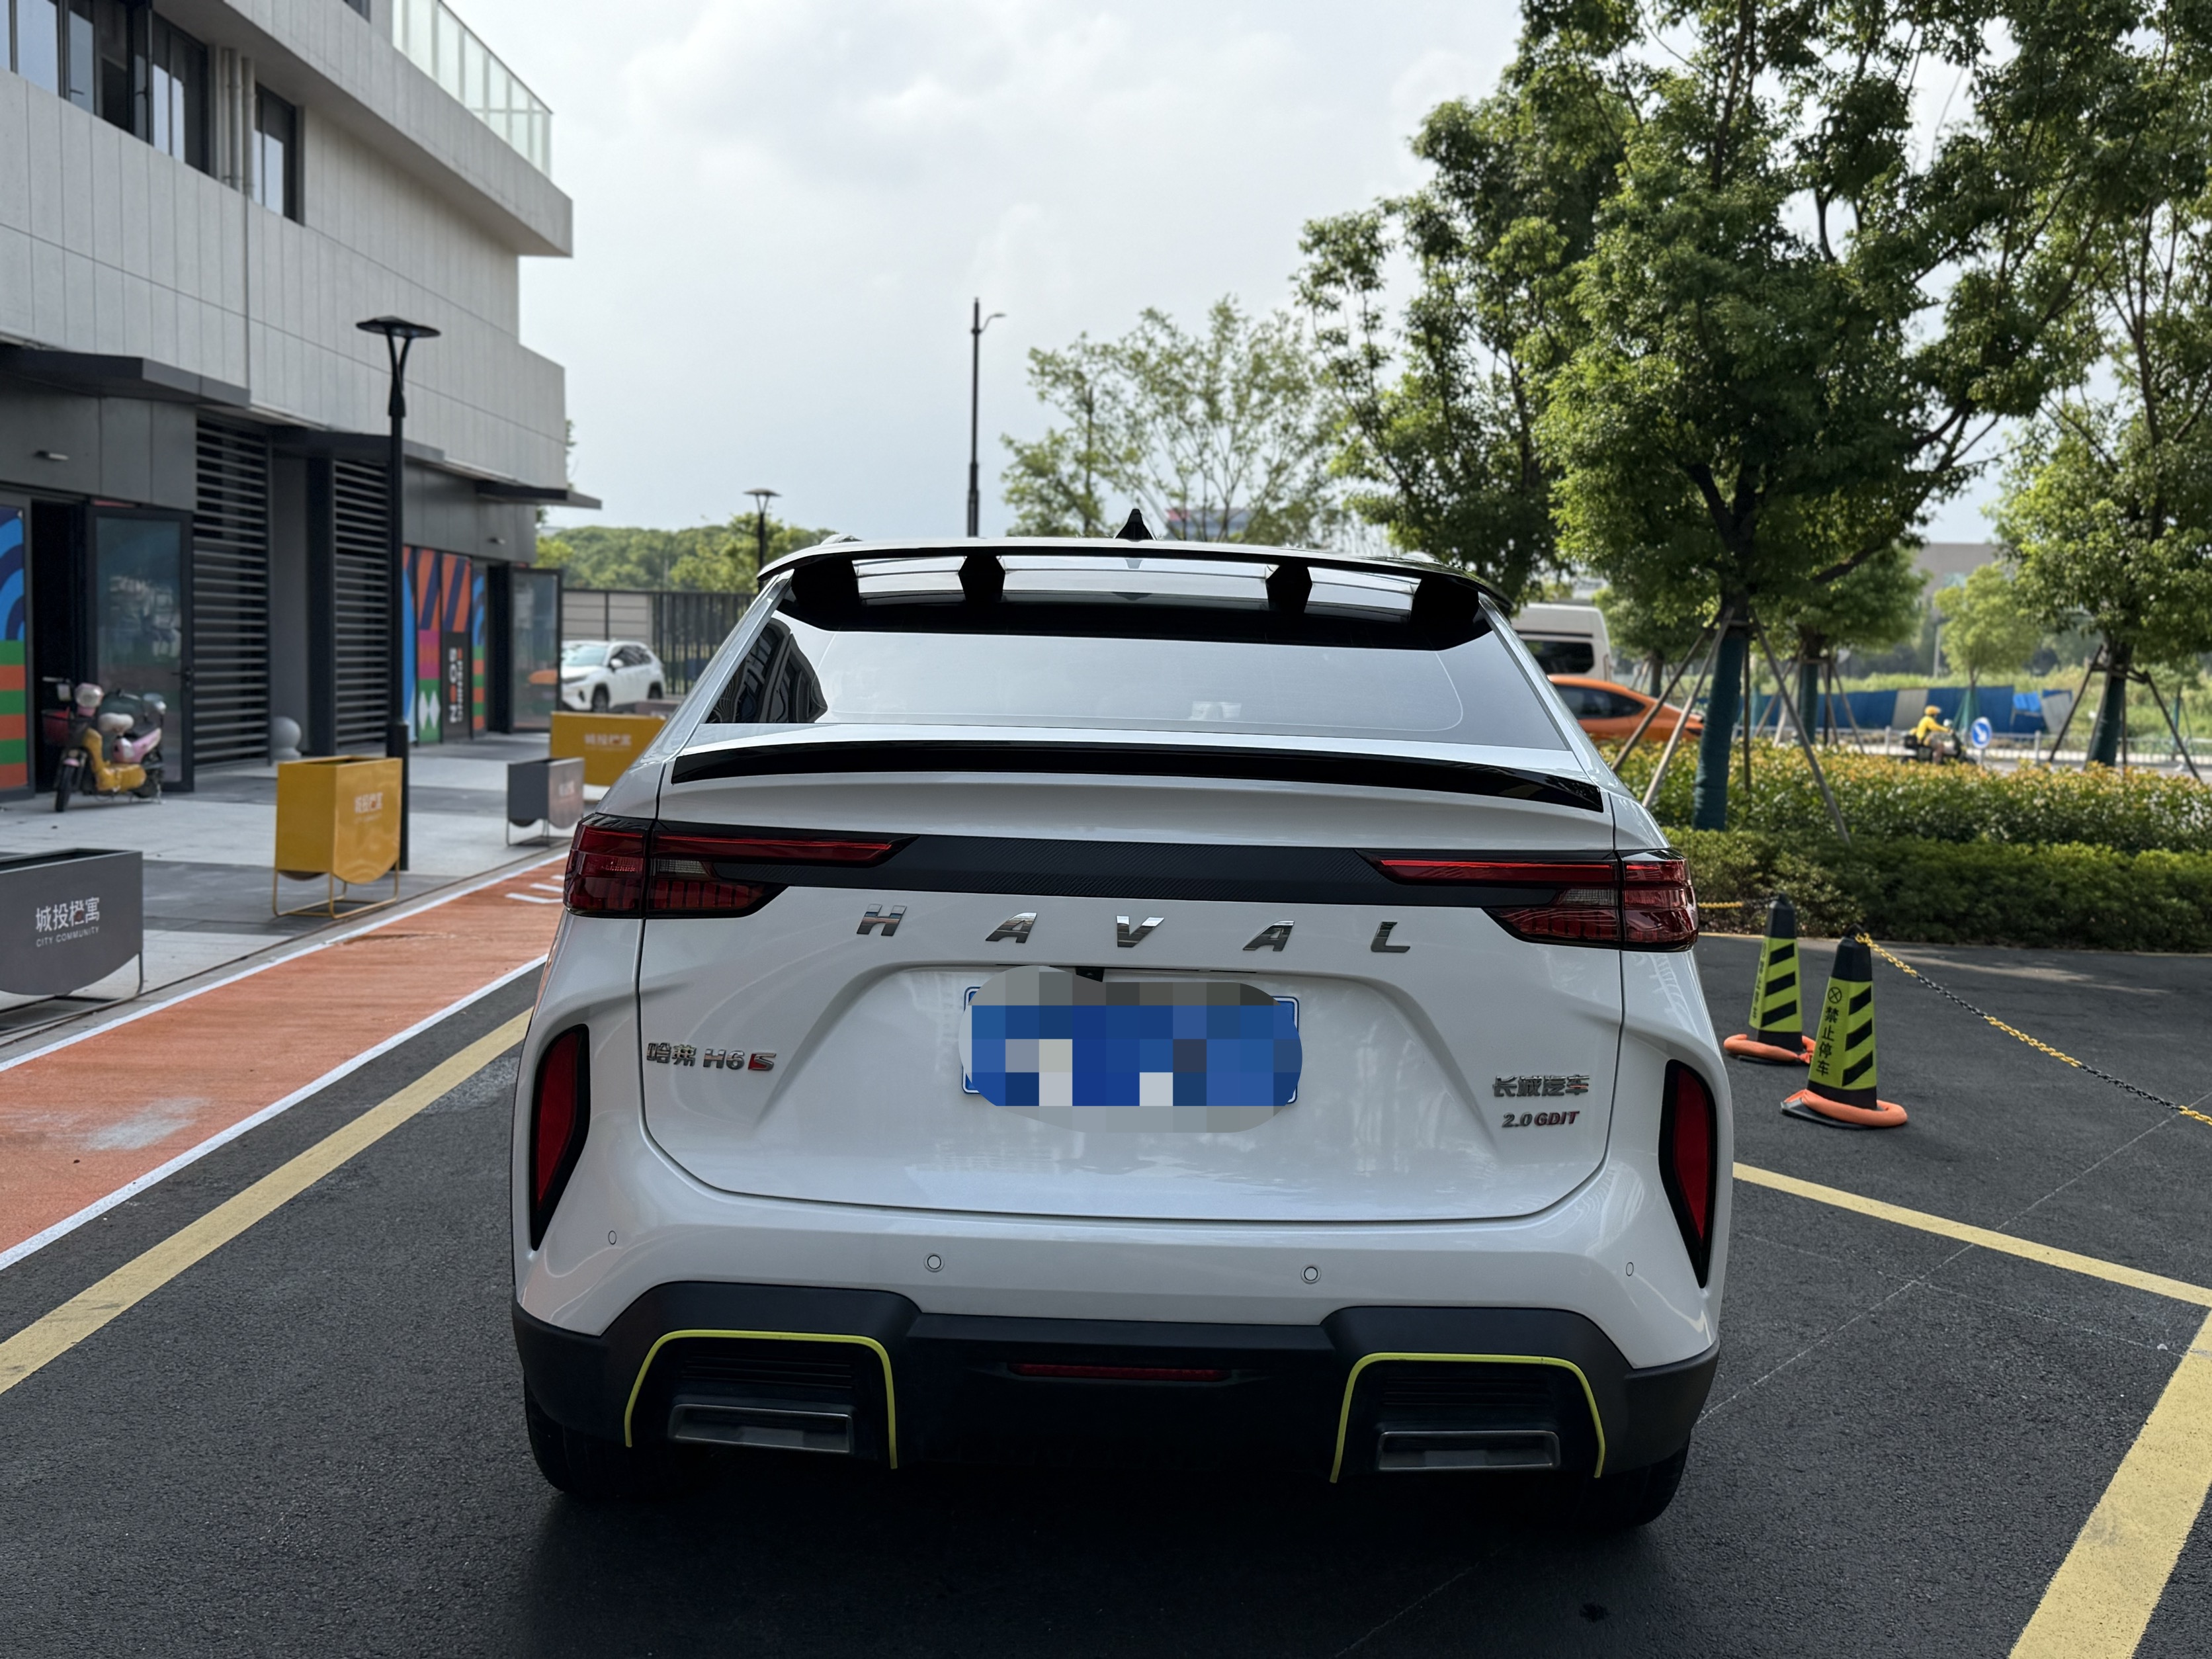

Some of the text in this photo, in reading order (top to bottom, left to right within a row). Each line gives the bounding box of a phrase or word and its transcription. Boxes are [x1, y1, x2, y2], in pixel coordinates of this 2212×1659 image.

[35, 896, 100, 933] 城投橙寓
[856, 903, 1411, 953] HAVAL
[36, 926, 99, 947] CITY COMMUNITY
[646, 1042, 697, 1067] 哈弗
[1816, 1006, 1839, 1076] 禁止停车
[1492, 1074, 1590, 1097] 长城汽车
